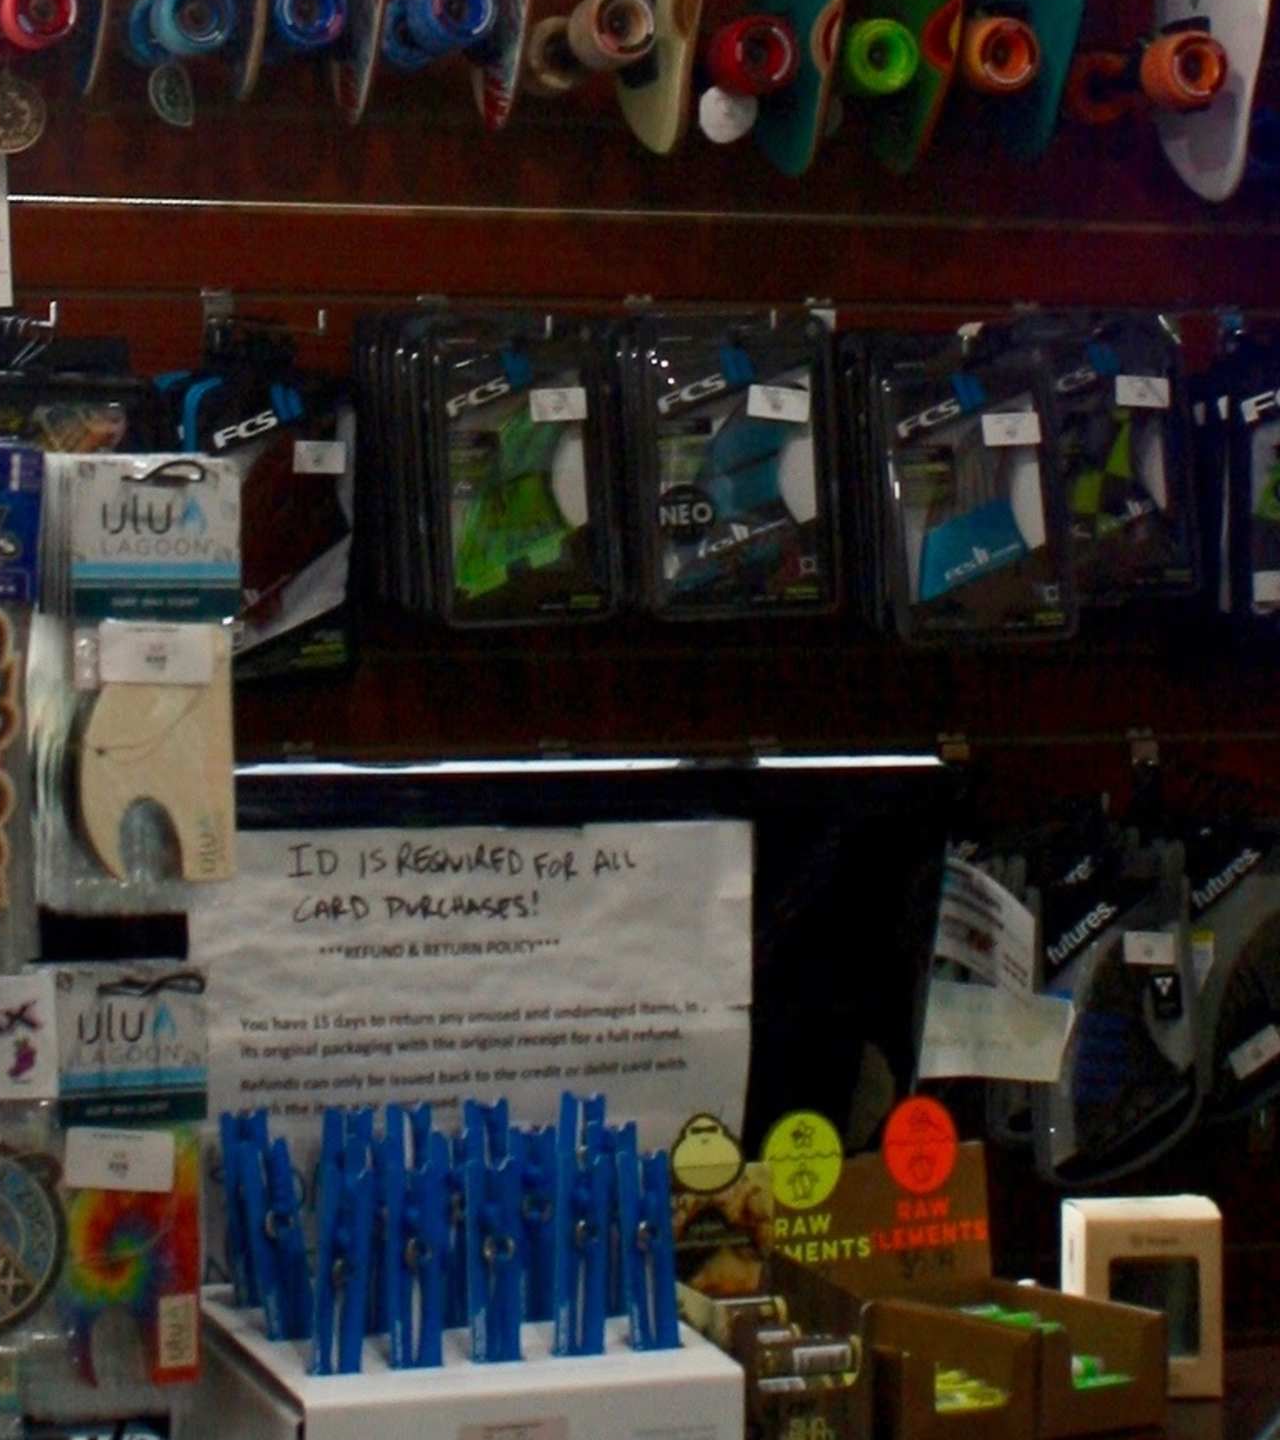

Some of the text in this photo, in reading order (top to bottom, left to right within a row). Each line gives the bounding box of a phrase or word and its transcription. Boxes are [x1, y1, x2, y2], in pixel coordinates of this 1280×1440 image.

[657, 372, 727, 415] FCS
[1054, 366, 1096, 393] CS
[445, 375, 511, 418] FCS
[213, 409, 280, 449] FCS
[897, 397, 961, 439] FCS
[659, 501, 713, 527] NEO
[101, 537, 213, 557] LAGOON
[288, 841, 637, 881] ID IS REQUIRED FOR ALL
[1191, 847, 1261, 911] futures.
[291, 894, 541, 923] CARD PURCHASES!
[1044, 899, 1117, 967] futures.
[407, 943, 420, 957] &
[423, 941, 482, 957] RETURN
[272, 1017, 308, 1030] have
[333, 1014, 367, 1032] days
[369, 1014, 386, 1028] to
[388, 1012, 435, 1026] return
[438, 1014, 465, 1028] any
[524, 1005, 550, 1020] and
[262, 1043, 318, 1061] original
[321, 1041, 392, 1059] packaging
[396, 1038, 429, 1051] with
[432, 1037, 456, 1050] the
[459, 1035, 514, 1053] original
[517, 1034, 567, 1048] receipt
[570, 1031, 590, 1044] for
[332, 1075, 363, 1091] only
[438, 1070, 471, 1083] back
[493, 1066, 517, 1080] the
[896, 1195, 950, 1221] RAW
[774, 1213, 833, 1238] RAW
[785, 1236, 871, 1263] MENTS
